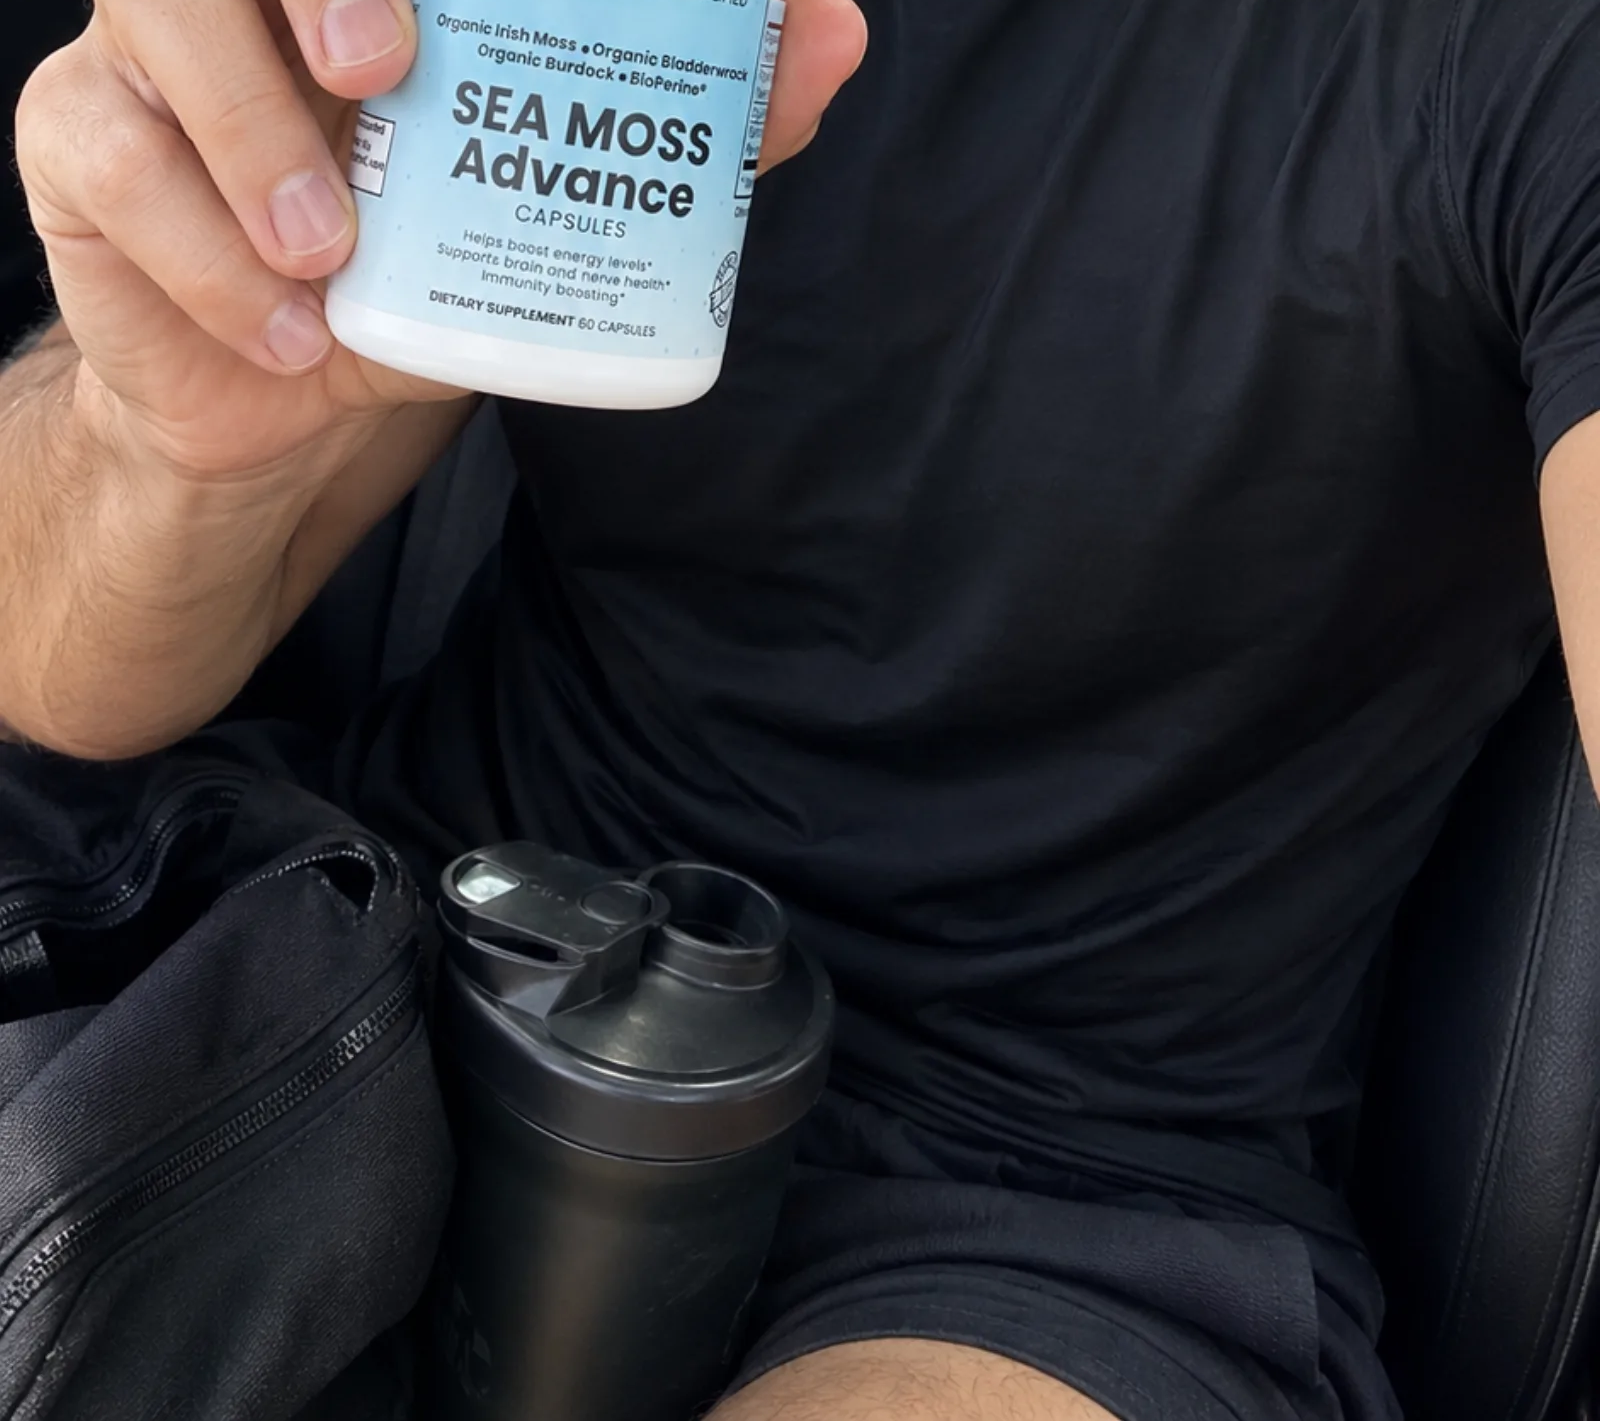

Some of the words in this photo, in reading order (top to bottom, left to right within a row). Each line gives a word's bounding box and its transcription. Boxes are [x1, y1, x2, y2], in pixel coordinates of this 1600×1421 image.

[436, 12, 493, 34] Organic
[494, 23, 530, 43] Irish
[533, 30, 577, 52] Moss
[592, 42, 659, 67] Organic
[660, 54, 749, 82] Bladderwrack
[477, 42, 542, 64] Organic
[545, 56, 616, 81] Burdock
[452, 80, 549, 140] SEA
[565, 101, 713, 166] MOSS
[450, 136, 695, 218] Advance
[514, 204, 627, 239] CAPSULES
[436, 242, 500, 266] Supports
[504, 256, 544, 275] brain
[546, 265, 578, 281] and
[580, 270, 621, 286] nerve
[463, 229, 504, 249] Helps
[552, 248, 605, 269] energy
[480, 269, 552, 297] Immunity
[429, 289, 485, 312] DIETARY
[486, 301, 577, 328] SUPPLEMENT
[577, 317, 596, 331] 60
[597, 319, 657, 338] CAPSULES
